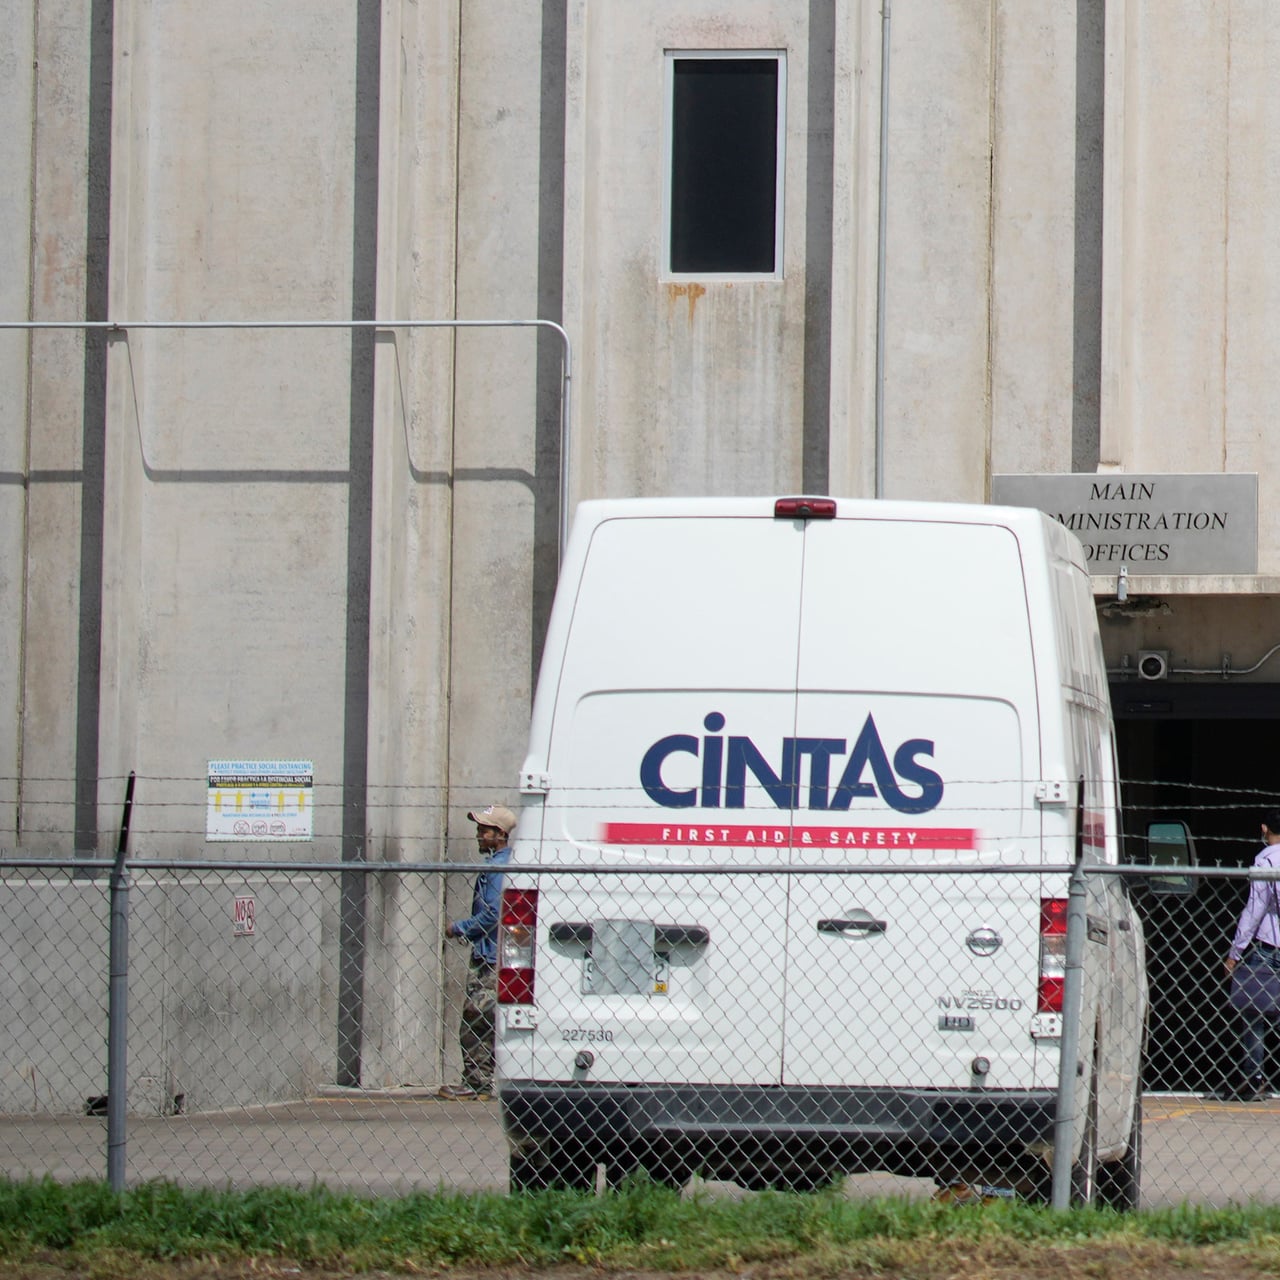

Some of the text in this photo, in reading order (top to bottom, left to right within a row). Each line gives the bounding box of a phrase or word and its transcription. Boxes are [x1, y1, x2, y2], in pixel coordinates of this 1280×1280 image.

[1090, 482, 1156, 501] MAIN
[662, 828, 918, 845] FIRST AID & SAFETY
[938, 995, 1022, 1011] NV2500
[562, 1028, 614, 1042] 227530
